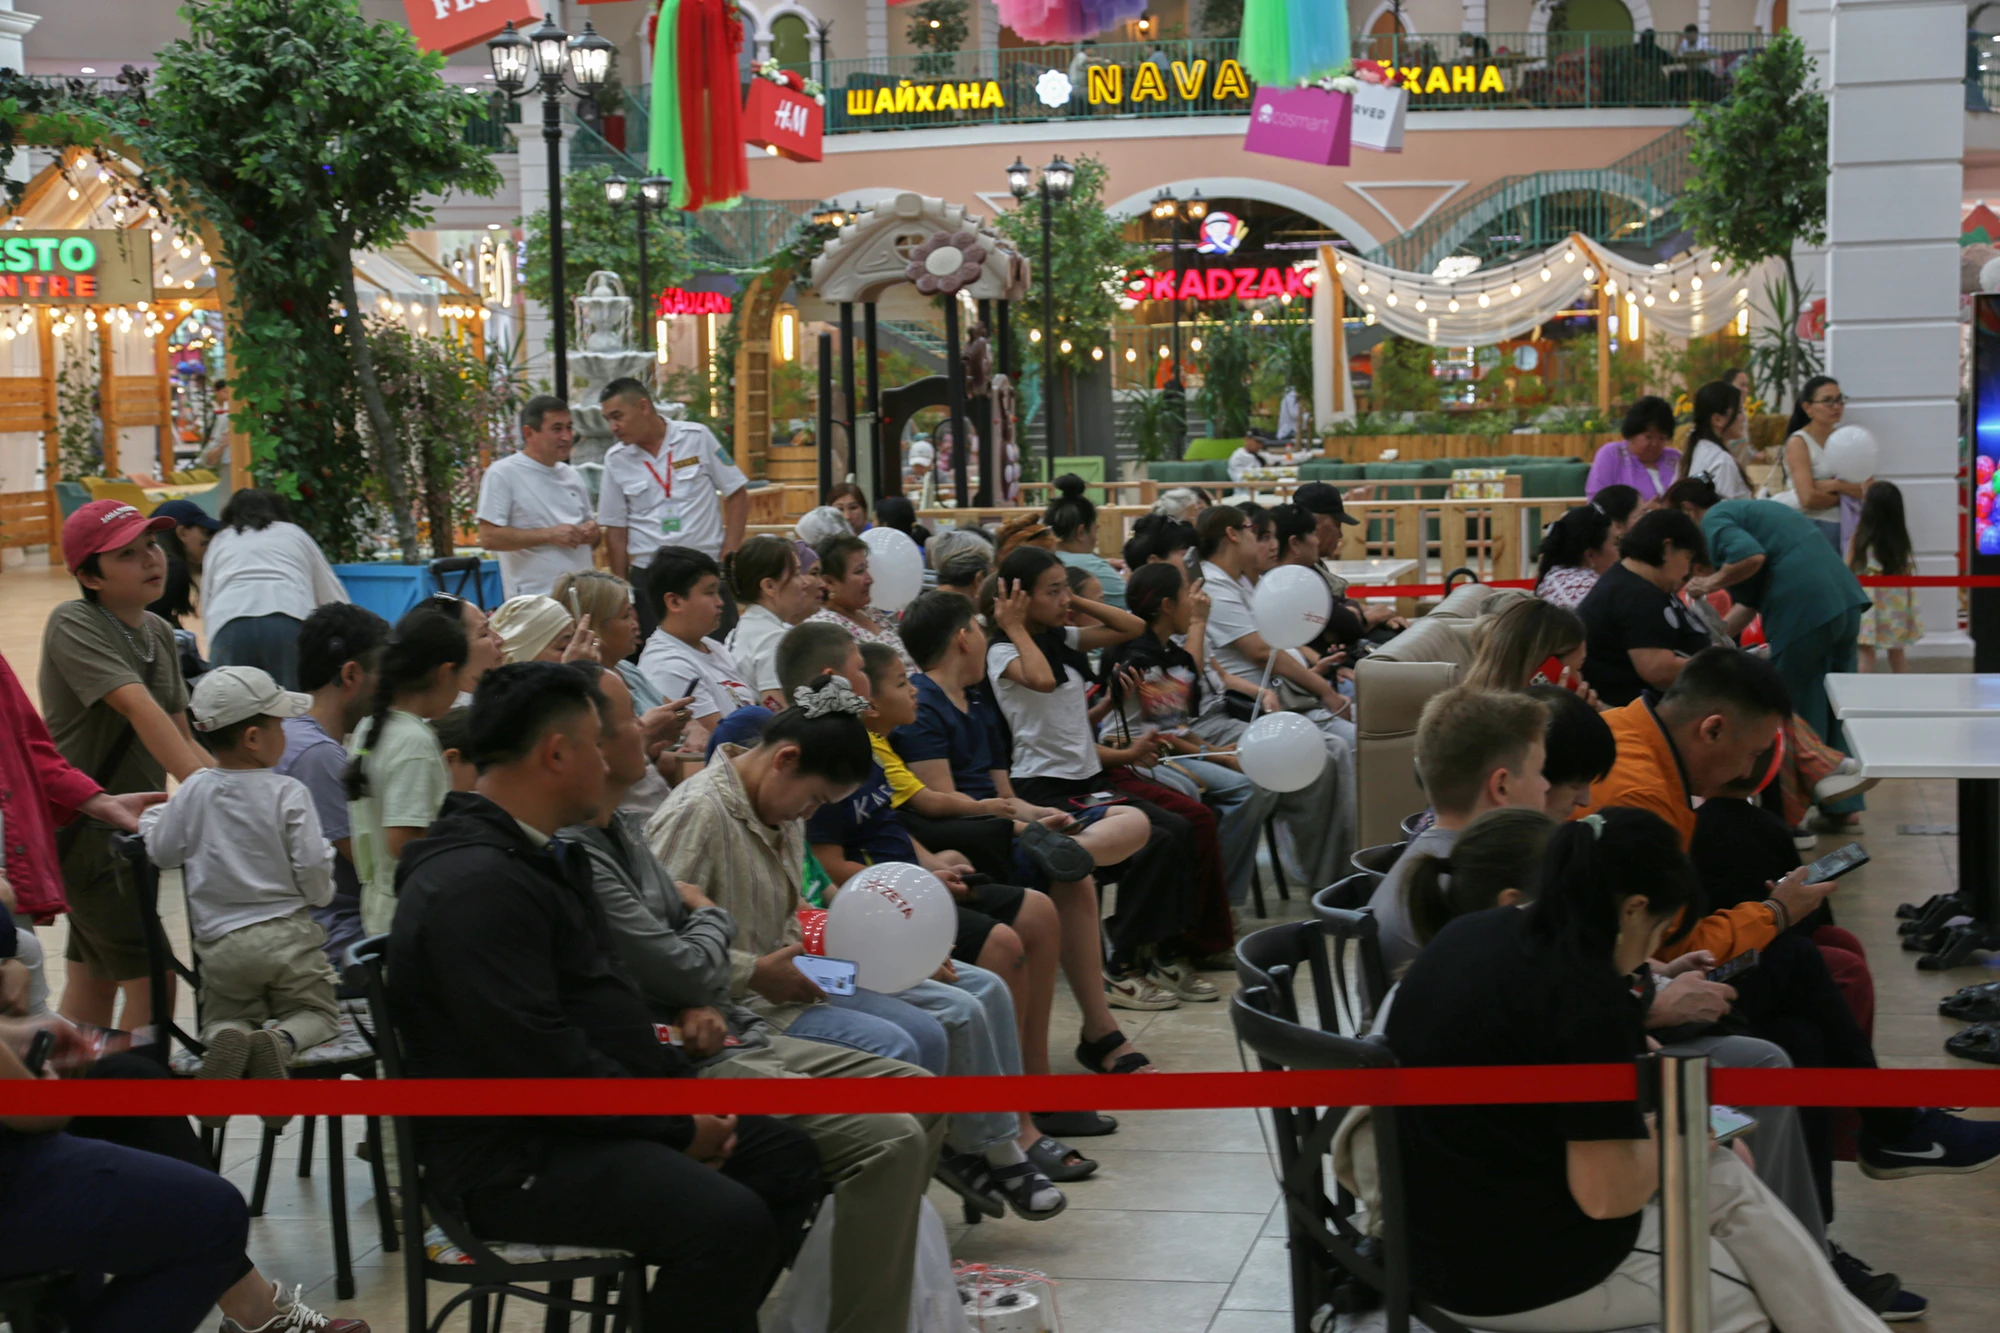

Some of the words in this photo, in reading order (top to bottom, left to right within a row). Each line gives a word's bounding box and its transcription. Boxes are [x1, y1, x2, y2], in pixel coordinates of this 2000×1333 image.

[847, 80, 1005, 115] ШАЙХАНА
[1087, 59, 1250, 105] NAVA
[774, 99, 808, 138] H&M
[0, 236, 97, 272] STO
